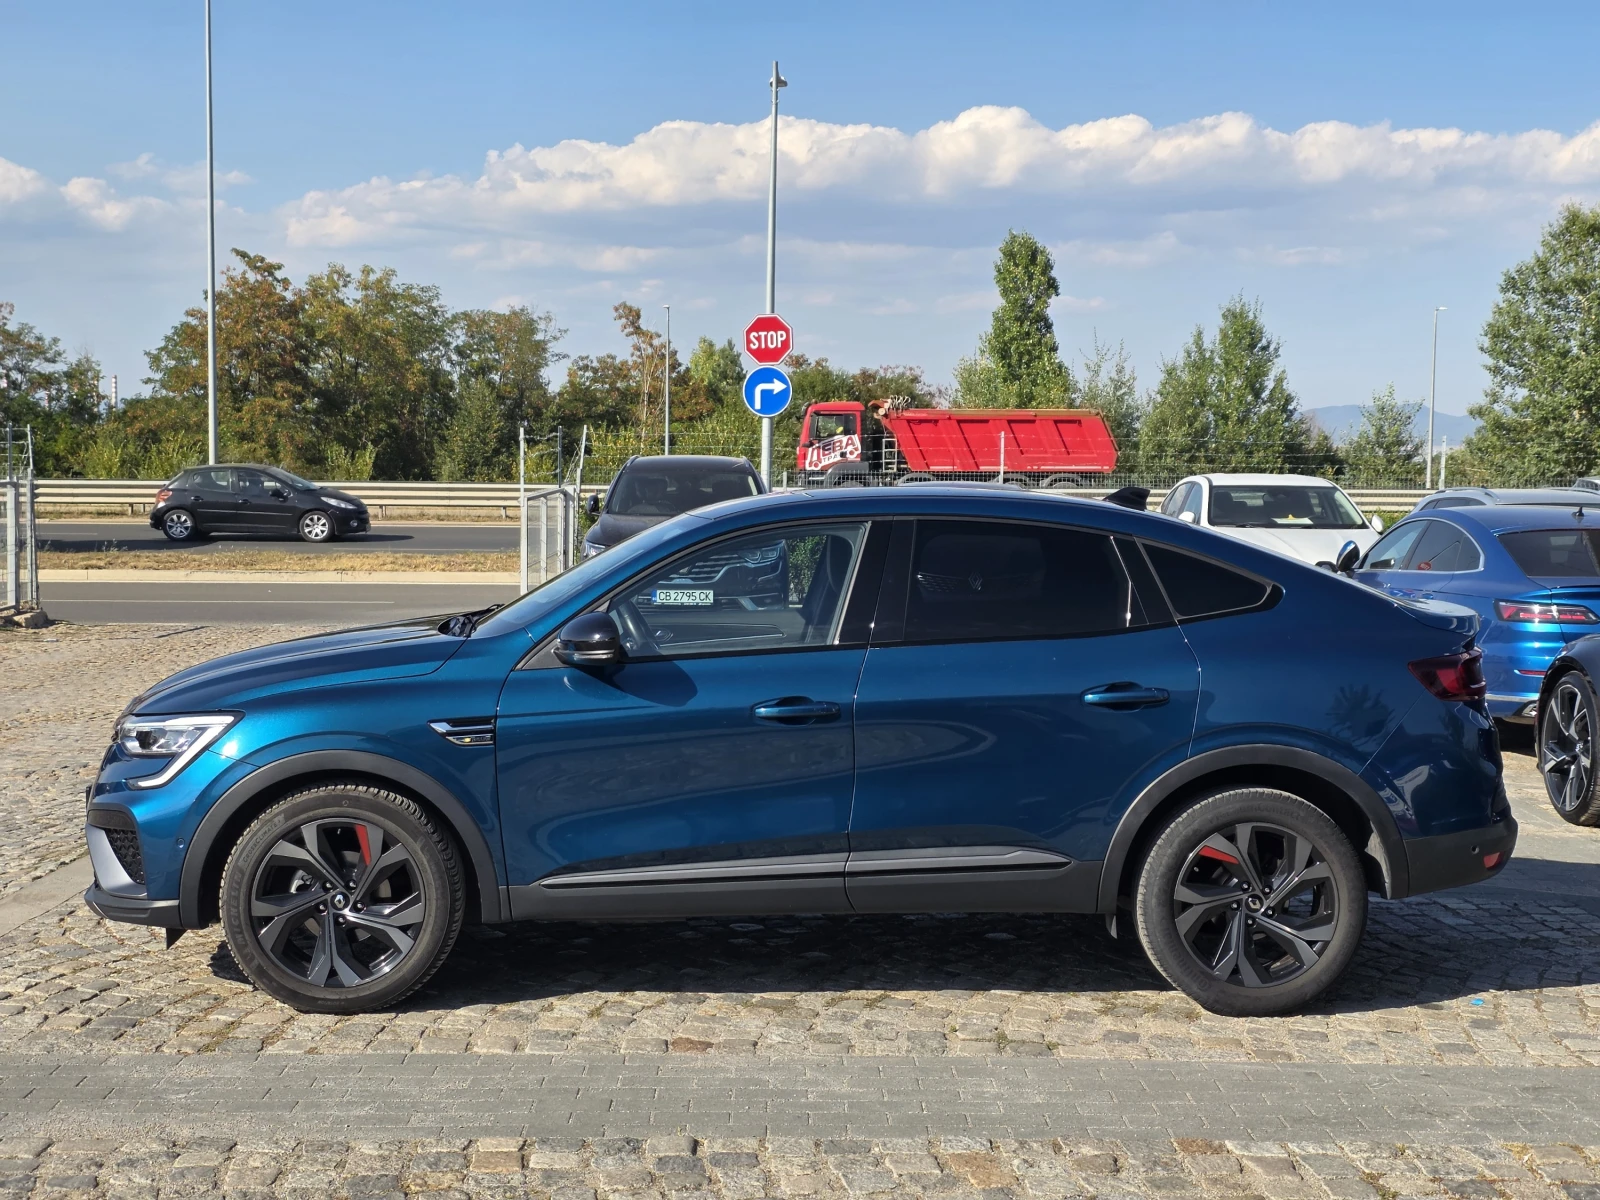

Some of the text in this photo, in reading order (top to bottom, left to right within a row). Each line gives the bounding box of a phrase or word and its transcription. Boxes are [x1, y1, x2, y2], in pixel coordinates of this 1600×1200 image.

[749, 331, 787, 349] STOP
[658, 591, 711, 601] CB 2795 CK
[230, 869, 245, 945] MICHELIN
